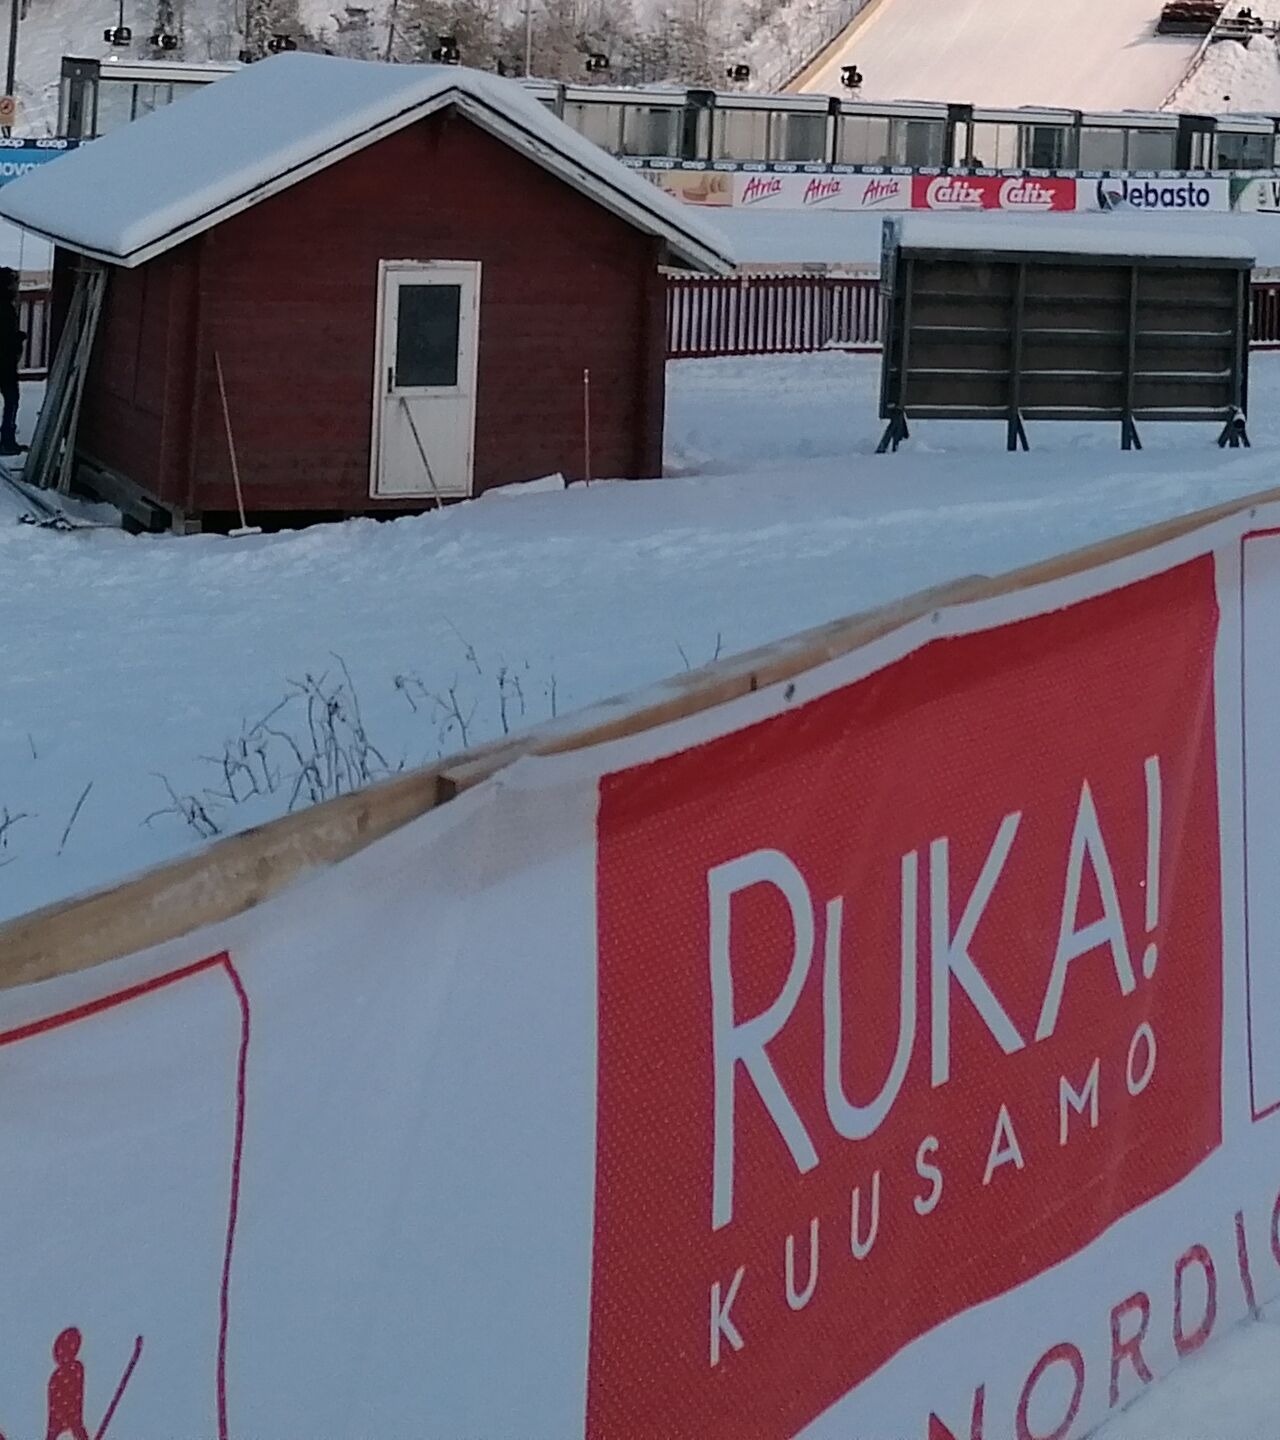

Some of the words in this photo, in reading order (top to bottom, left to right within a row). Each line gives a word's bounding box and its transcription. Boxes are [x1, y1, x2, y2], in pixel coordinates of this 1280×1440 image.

[36, 139, 68, 150] coop
[742, 176, 782, 203] Atria
[803, 177, 841, 203] Atria
[861, 177, 900, 205] Atria
[926, 177, 984, 209] Calix
[999, 178, 1056, 209] Calix
[707, 754, 1163, 1229] RUKA!
[707, 1022, 1157, 1368] KUUSAMO
